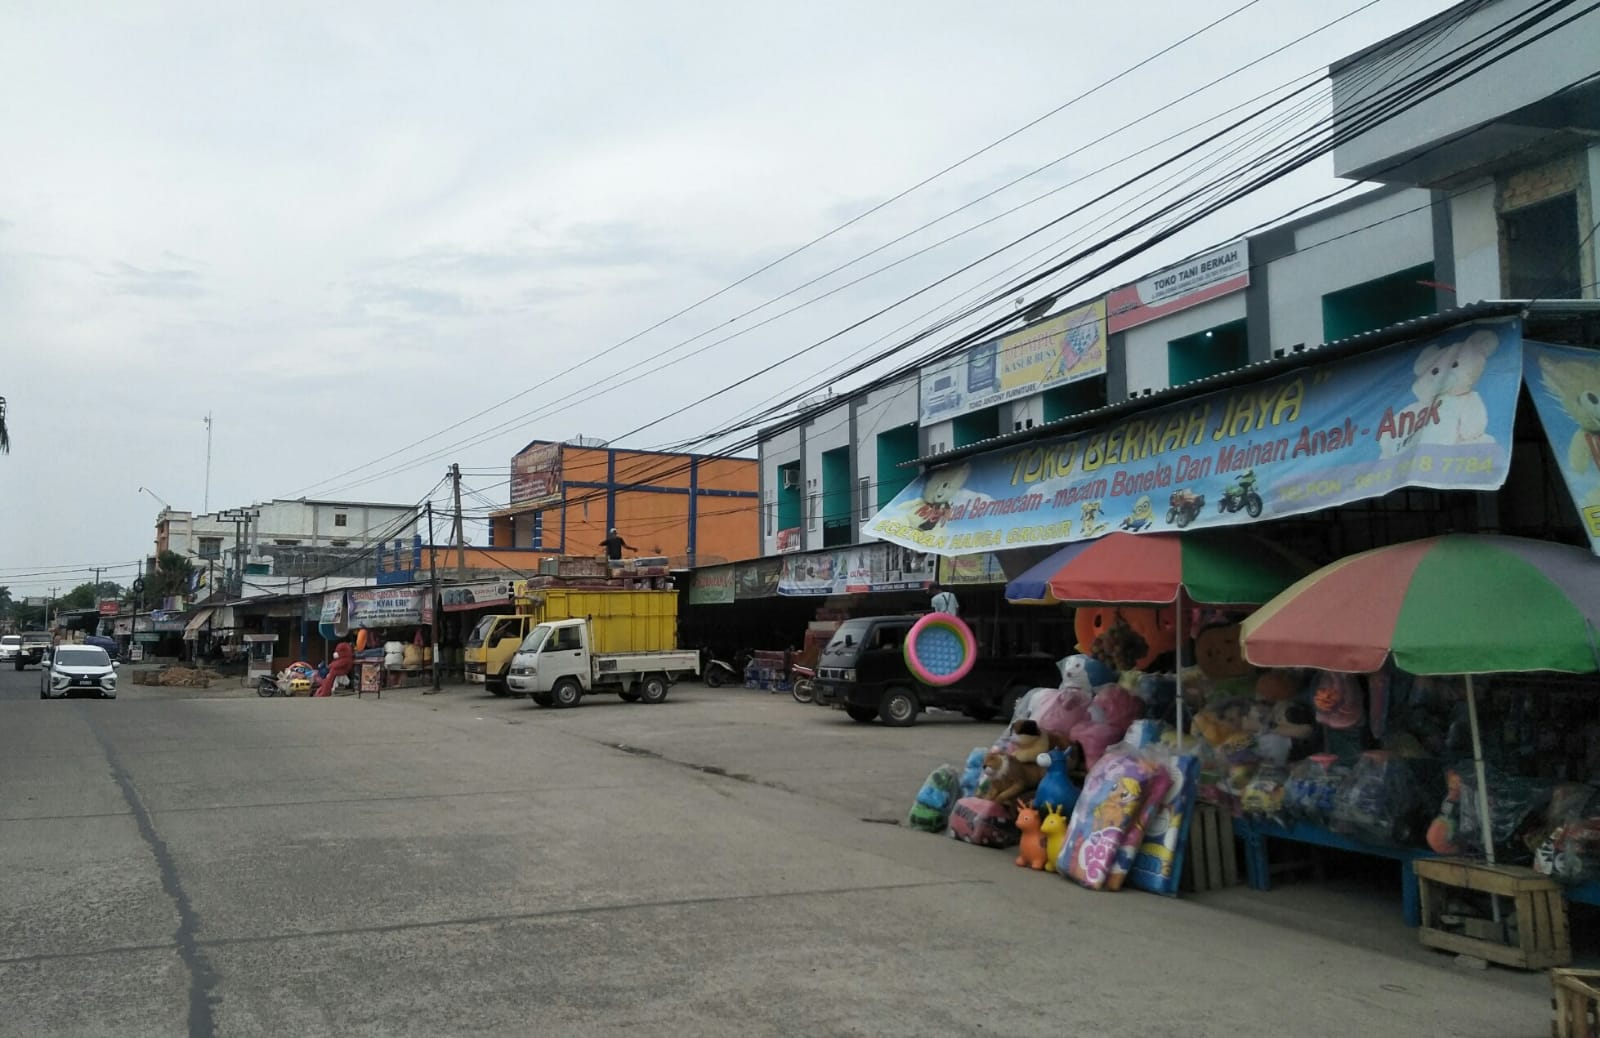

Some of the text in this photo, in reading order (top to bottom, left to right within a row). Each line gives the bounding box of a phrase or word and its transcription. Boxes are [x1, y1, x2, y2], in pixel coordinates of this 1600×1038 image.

[1153, 250, 1238, 291] TOKO TANI BERKAH
[1005, 383, 1038, 403] FURNITURE
[968, 492, 1043, 520] Bermacam
[1052, 477, 1107, 509] macam
[1110, 463, 1173, 498] Boneka
[1174, 453, 1210, 484] Dan
[1214, 437, 1289, 476] Mainan
[1292, 418, 1358, 459] Anak
[1376, 399, 1444, 441] Anak
[1081, 403, 1212, 472] BERKAH
